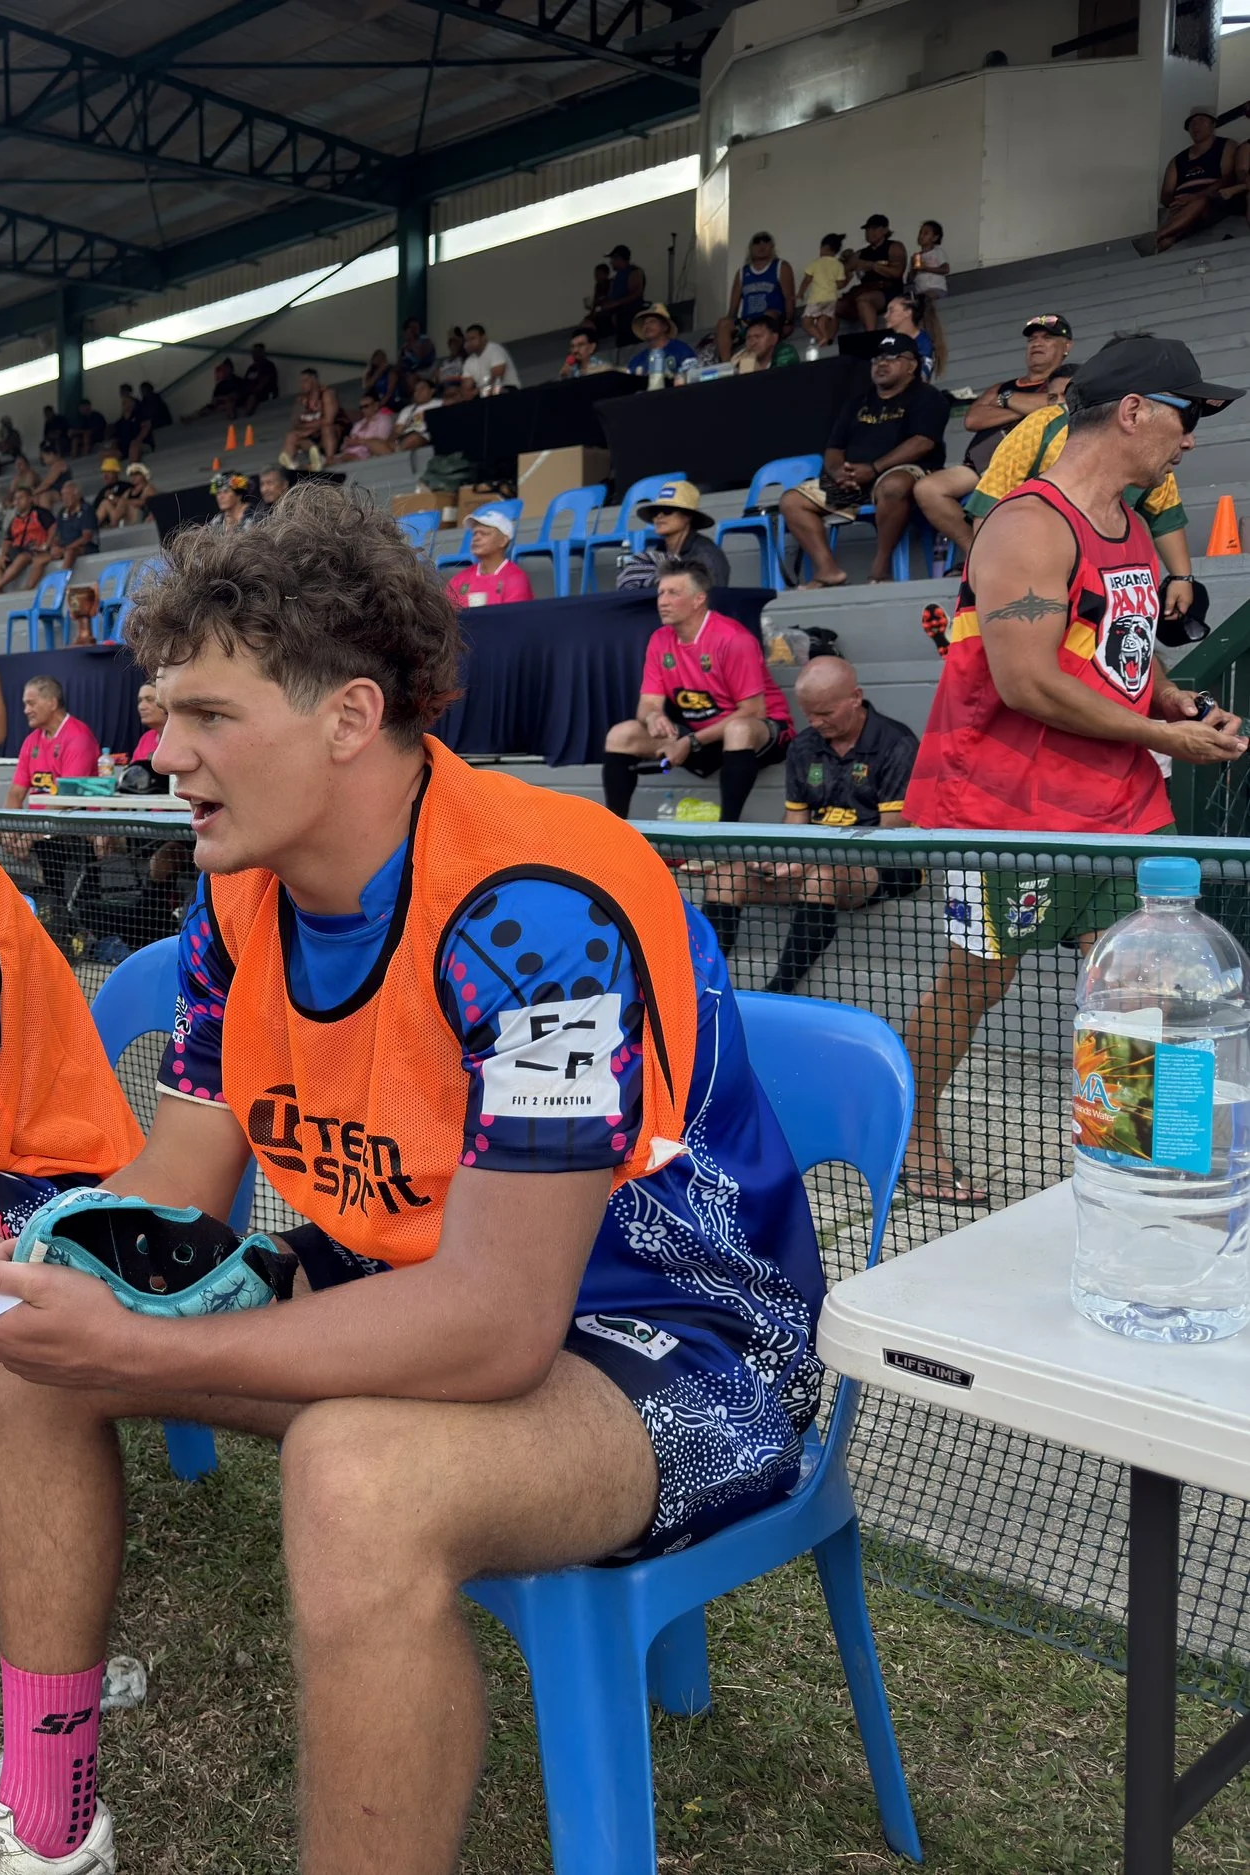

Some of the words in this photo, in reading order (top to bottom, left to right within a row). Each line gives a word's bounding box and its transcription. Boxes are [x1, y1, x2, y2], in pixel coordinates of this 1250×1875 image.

[512, 1096, 527, 1105] FIT
[532, 1096, 538, 1106] 2
[543, 1095, 592, 1106] FUNCTION
[894, 1354, 963, 1384] LIFETIME
[31, 1706, 94, 1735] SP
